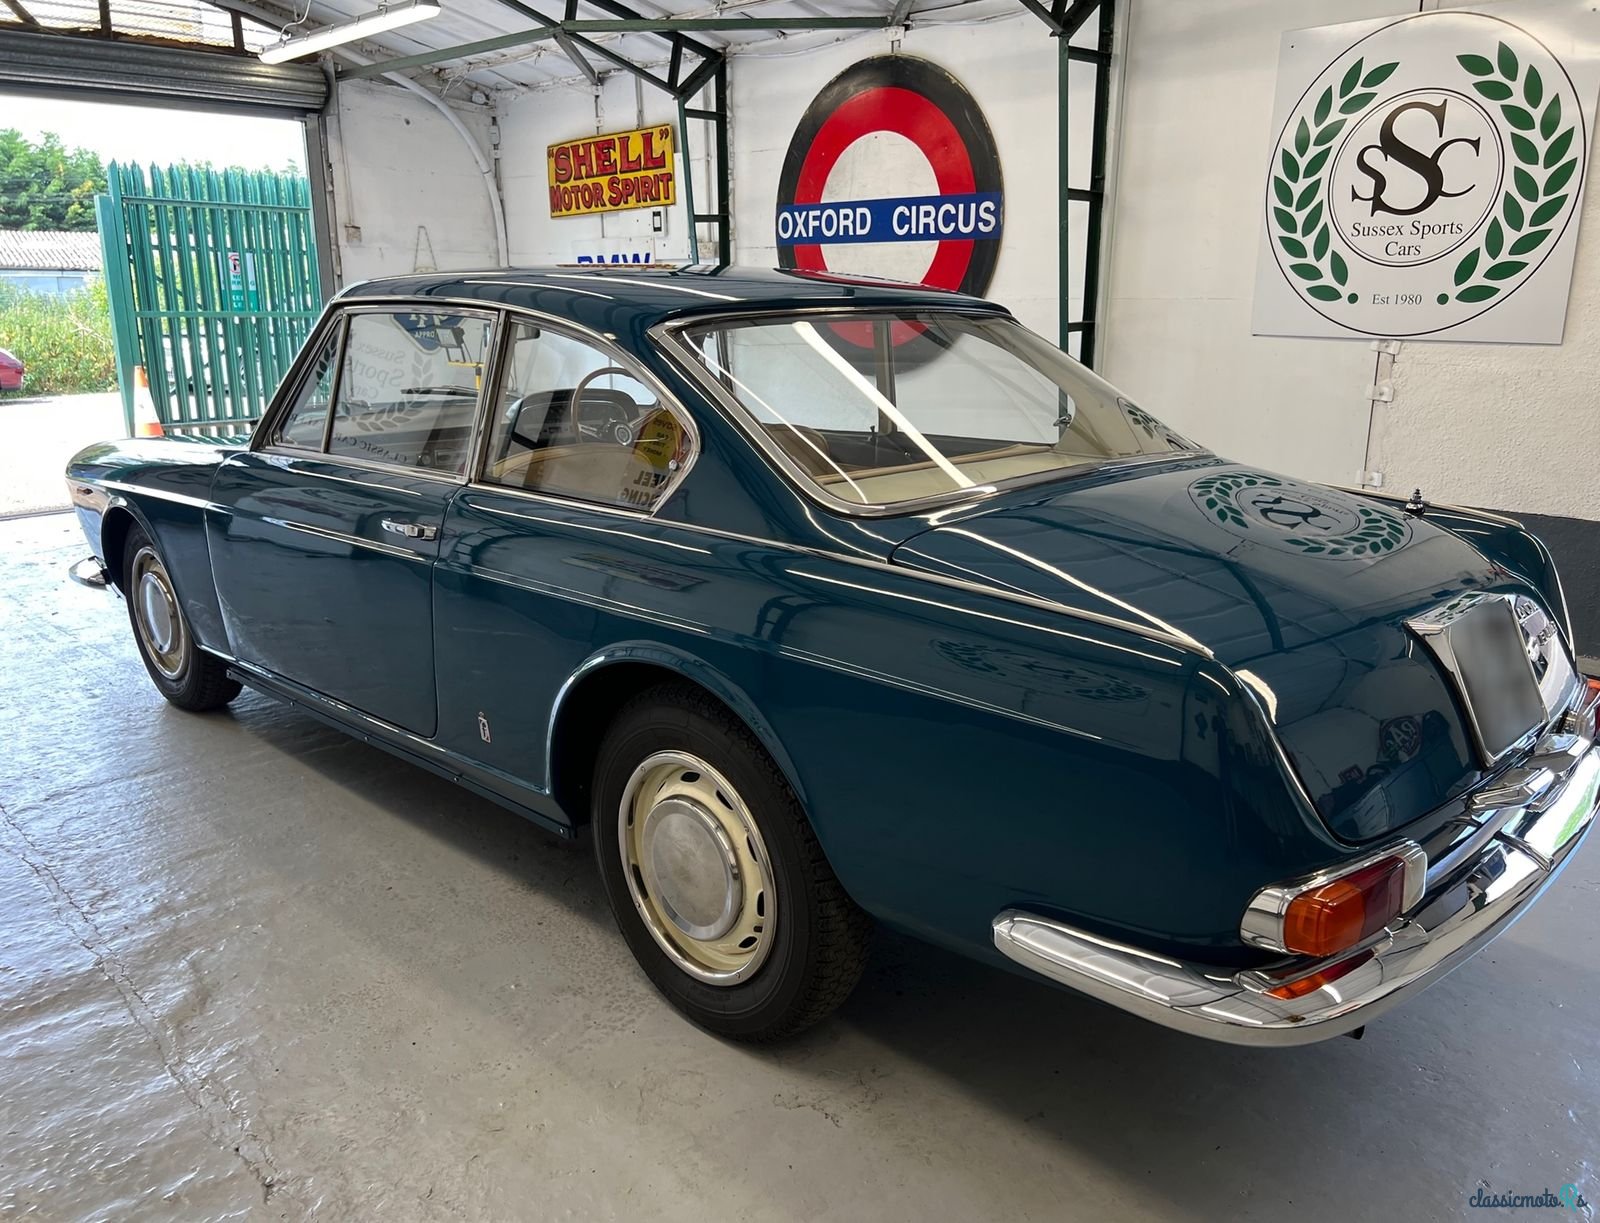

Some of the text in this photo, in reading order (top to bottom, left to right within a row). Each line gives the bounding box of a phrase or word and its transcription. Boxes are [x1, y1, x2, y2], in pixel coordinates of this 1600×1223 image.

[550, 172, 673, 213] MOTOR SPIRIT
[778, 201, 997, 239] OXFORD CIRCUS
[1351, 220, 1464, 239] Sussex Sports
[1384, 241, 1422, 256] Cars
[1372, 293, 1423, 305] Est 1980
